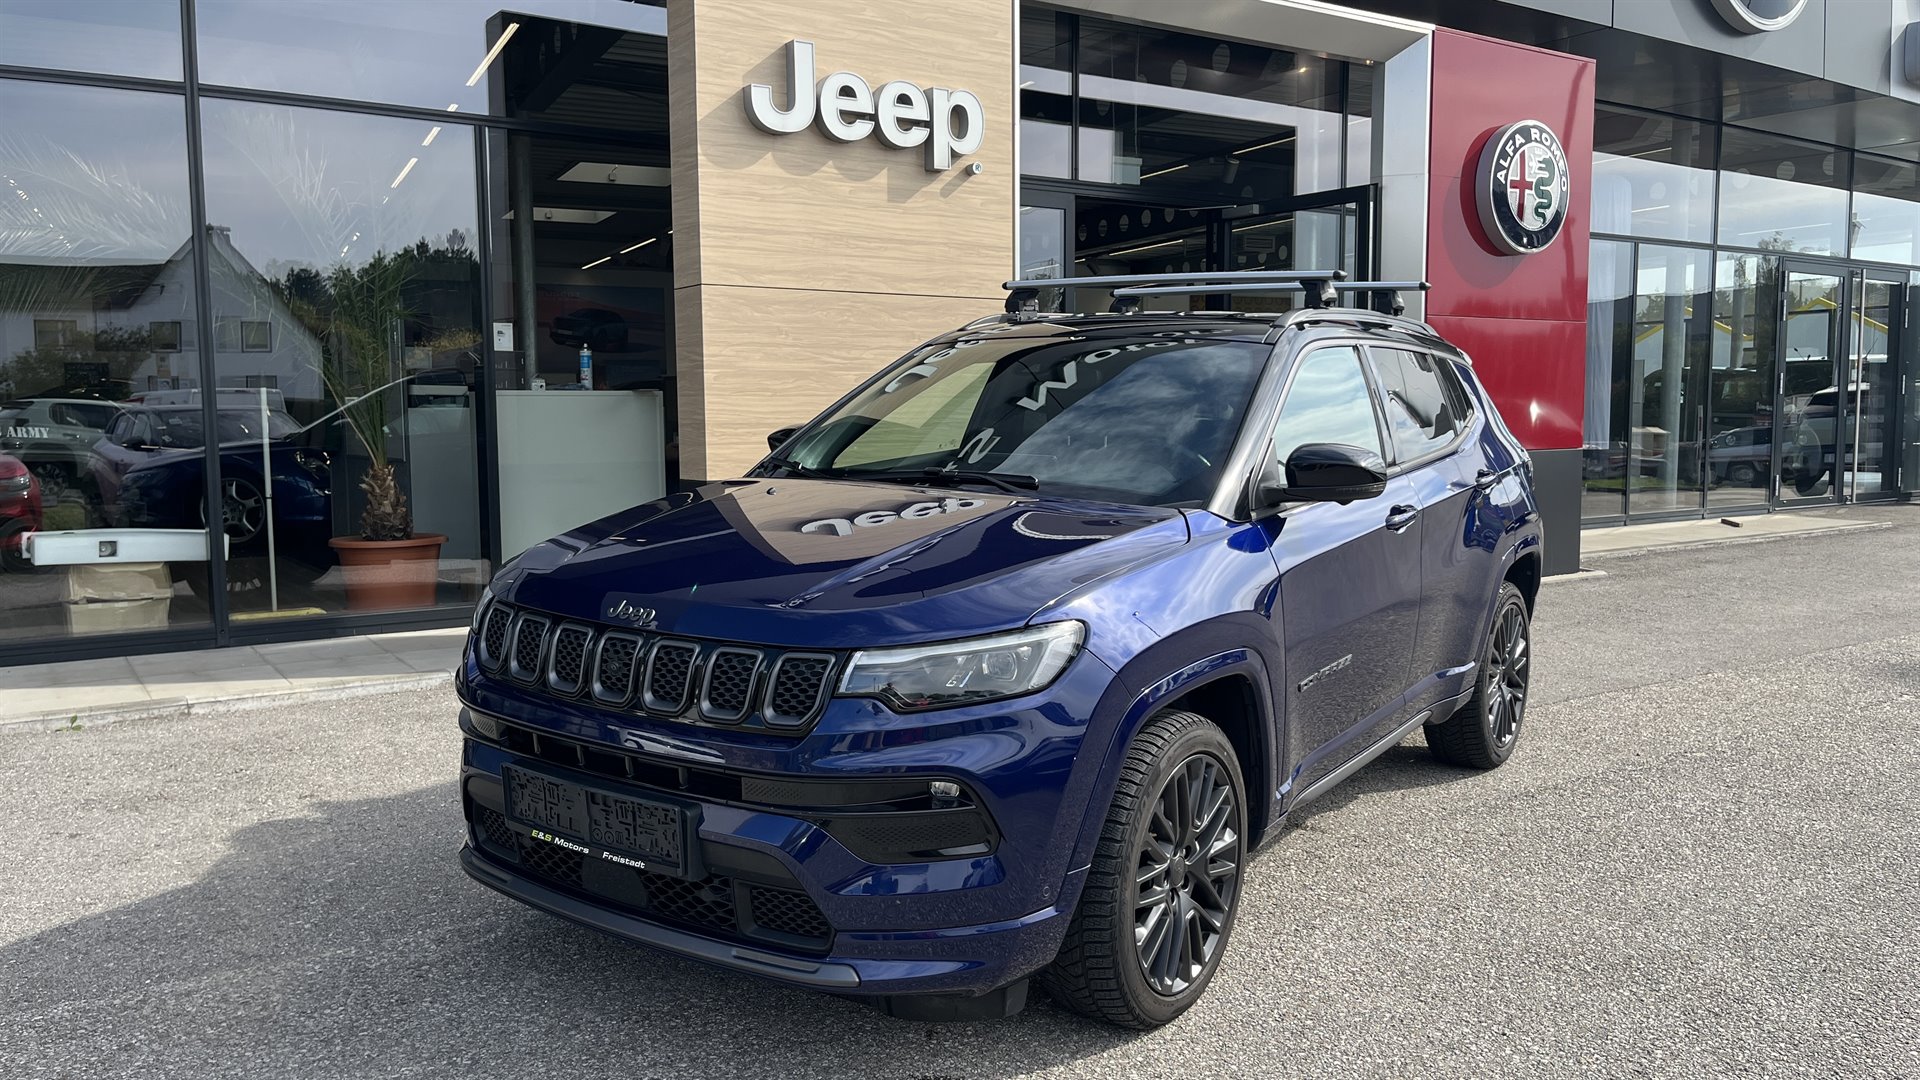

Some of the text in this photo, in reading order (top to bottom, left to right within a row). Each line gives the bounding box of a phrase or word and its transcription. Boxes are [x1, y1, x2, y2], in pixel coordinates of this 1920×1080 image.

[744, 39, 985, 171] Jeep
[1497, 128, 1568, 192] ALFA ROMEO
[6, 426, 49, 438] ARMY
[607, 600, 656, 626] Jeep
[531, 829, 646, 869] E&S Motors Freistadt
